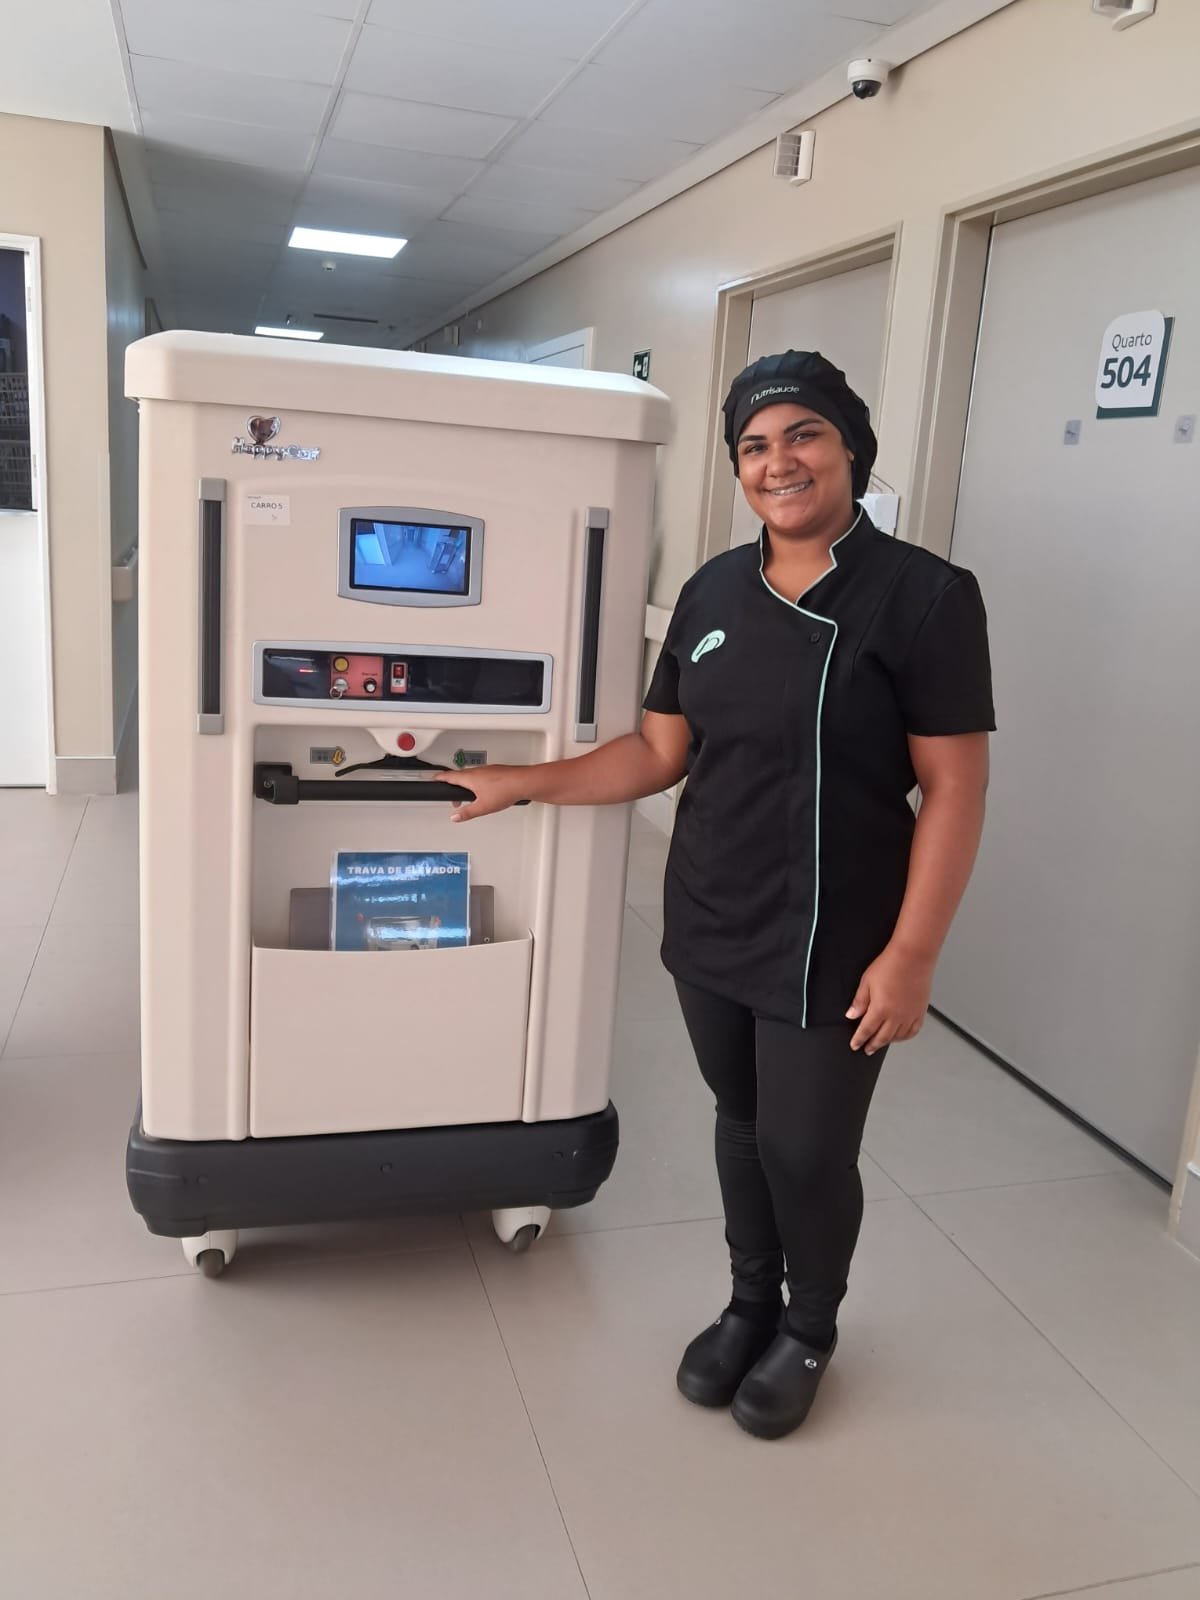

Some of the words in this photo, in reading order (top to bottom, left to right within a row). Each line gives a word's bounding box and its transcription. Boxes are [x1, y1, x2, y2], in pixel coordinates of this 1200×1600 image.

[1111, 332, 1153, 352] Quarto
[1100, 354, 1152, 389] 504
[250, 502, 277, 510] CARRO
[347, 866, 385, 875] TRAVA
[387, 866, 401, 875] DE
[404, 865, 461, 875] ELEVADOR
